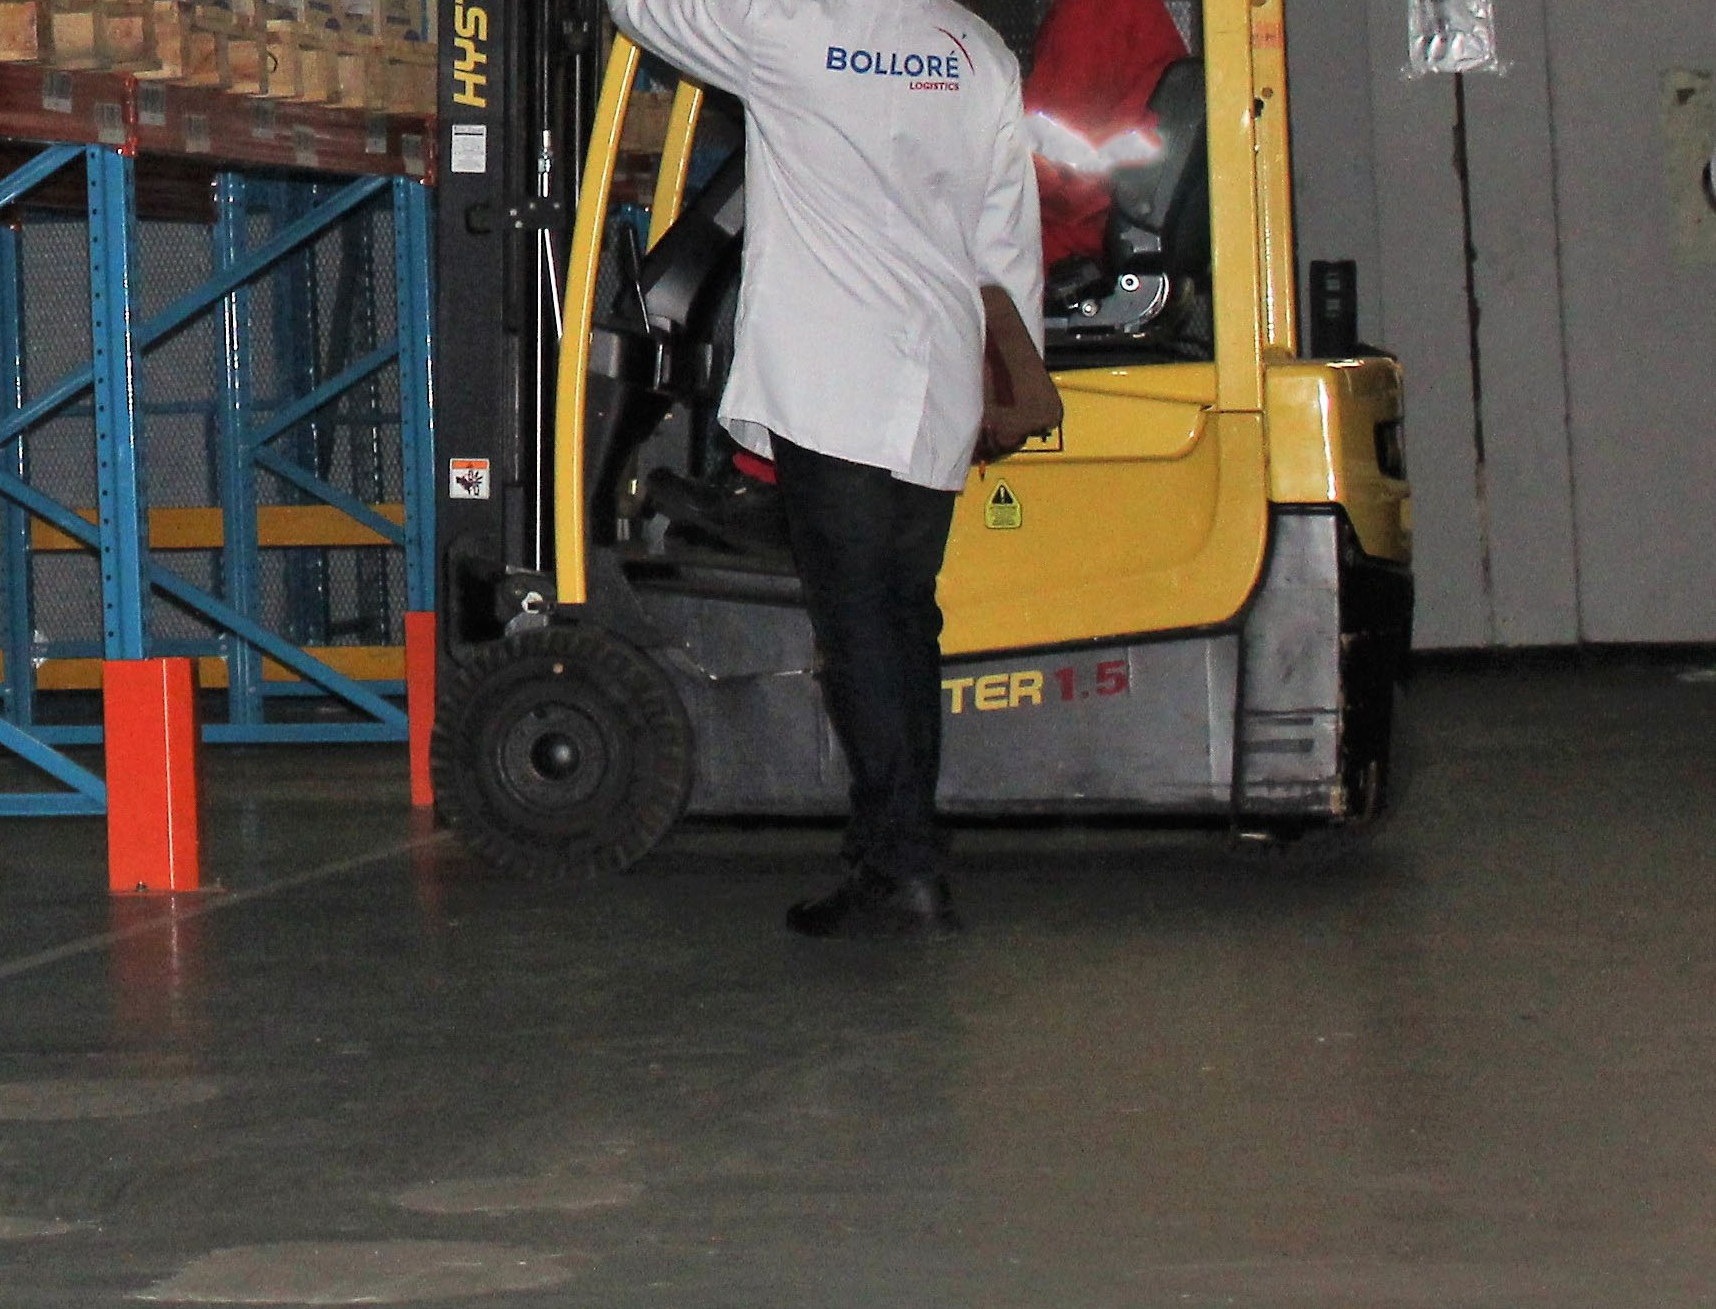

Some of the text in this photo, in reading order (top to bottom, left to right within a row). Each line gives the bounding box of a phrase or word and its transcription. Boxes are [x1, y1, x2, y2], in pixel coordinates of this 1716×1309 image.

[826, 46, 960, 79] BOLLORÉ
[909, 81, 960, 91] LOGISTICS
[941, 659, 1131, 715] TER 1.5
